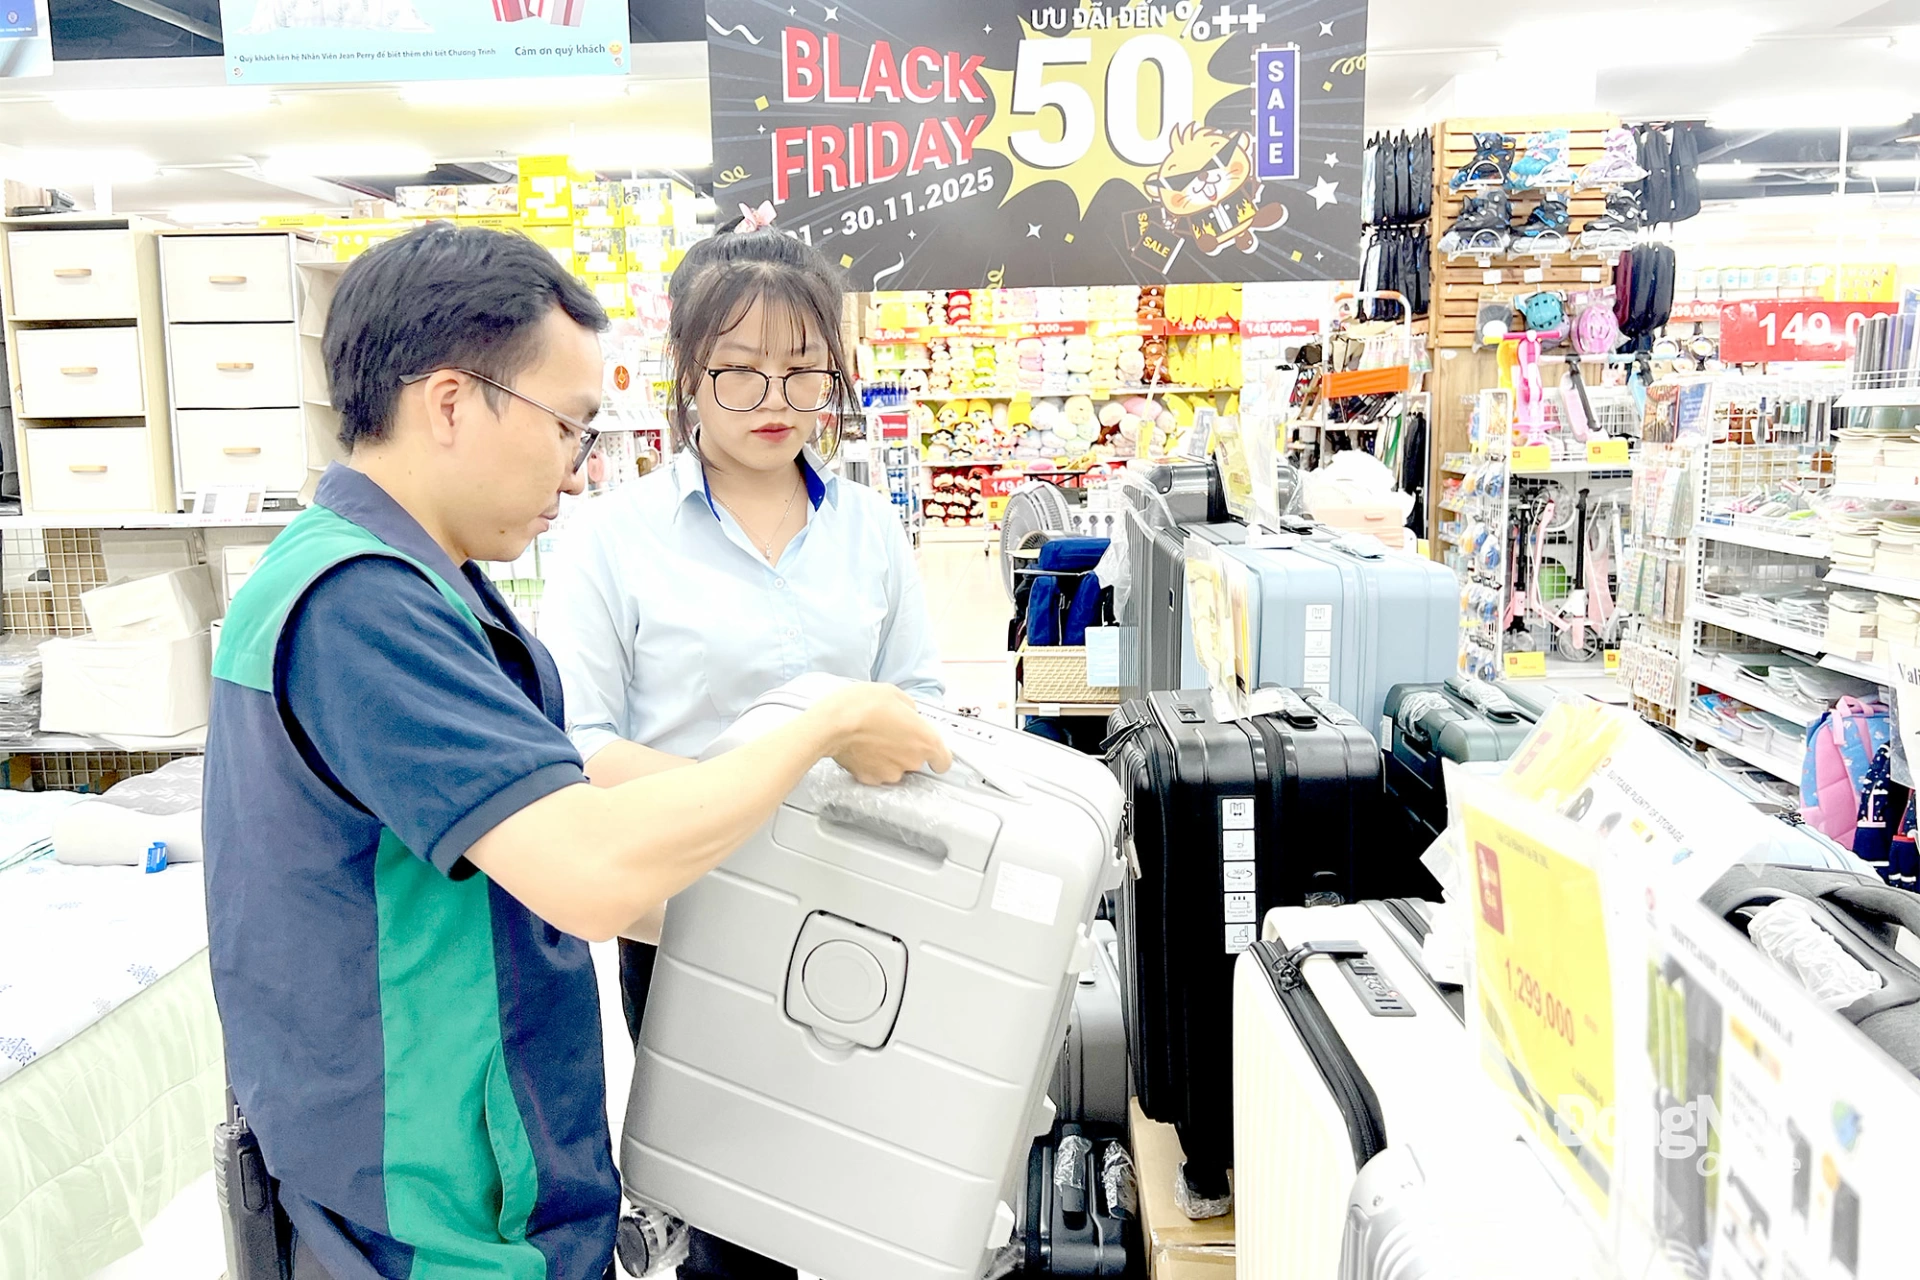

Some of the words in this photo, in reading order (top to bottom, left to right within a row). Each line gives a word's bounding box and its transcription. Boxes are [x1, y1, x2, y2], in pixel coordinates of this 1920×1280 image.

[514, 45, 536, 56] Cảm
[555, 44, 574, 57] quý
[576, 43, 606, 54] khách
[1030, 7, 1067, 30] ƯU
[1073, 3, 1112, 29] ĐÃI
[1118, 0, 1168, 28] ĐẾN
[339, 52, 355, 60] Jean
[356, 51, 375, 61] Perry
[781, 26, 988, 104] BLACK
[1008, 33, 1194, 169] 50
[1267, 60, 1285, 164] SALE
[771, 114, 988, 205] FRIDAY
[840, 166, 994, 236] 30.11.2025
[1142, 236, 1171, 258] SALE
[1505, 957, 1576, 1047] 1,299,000
